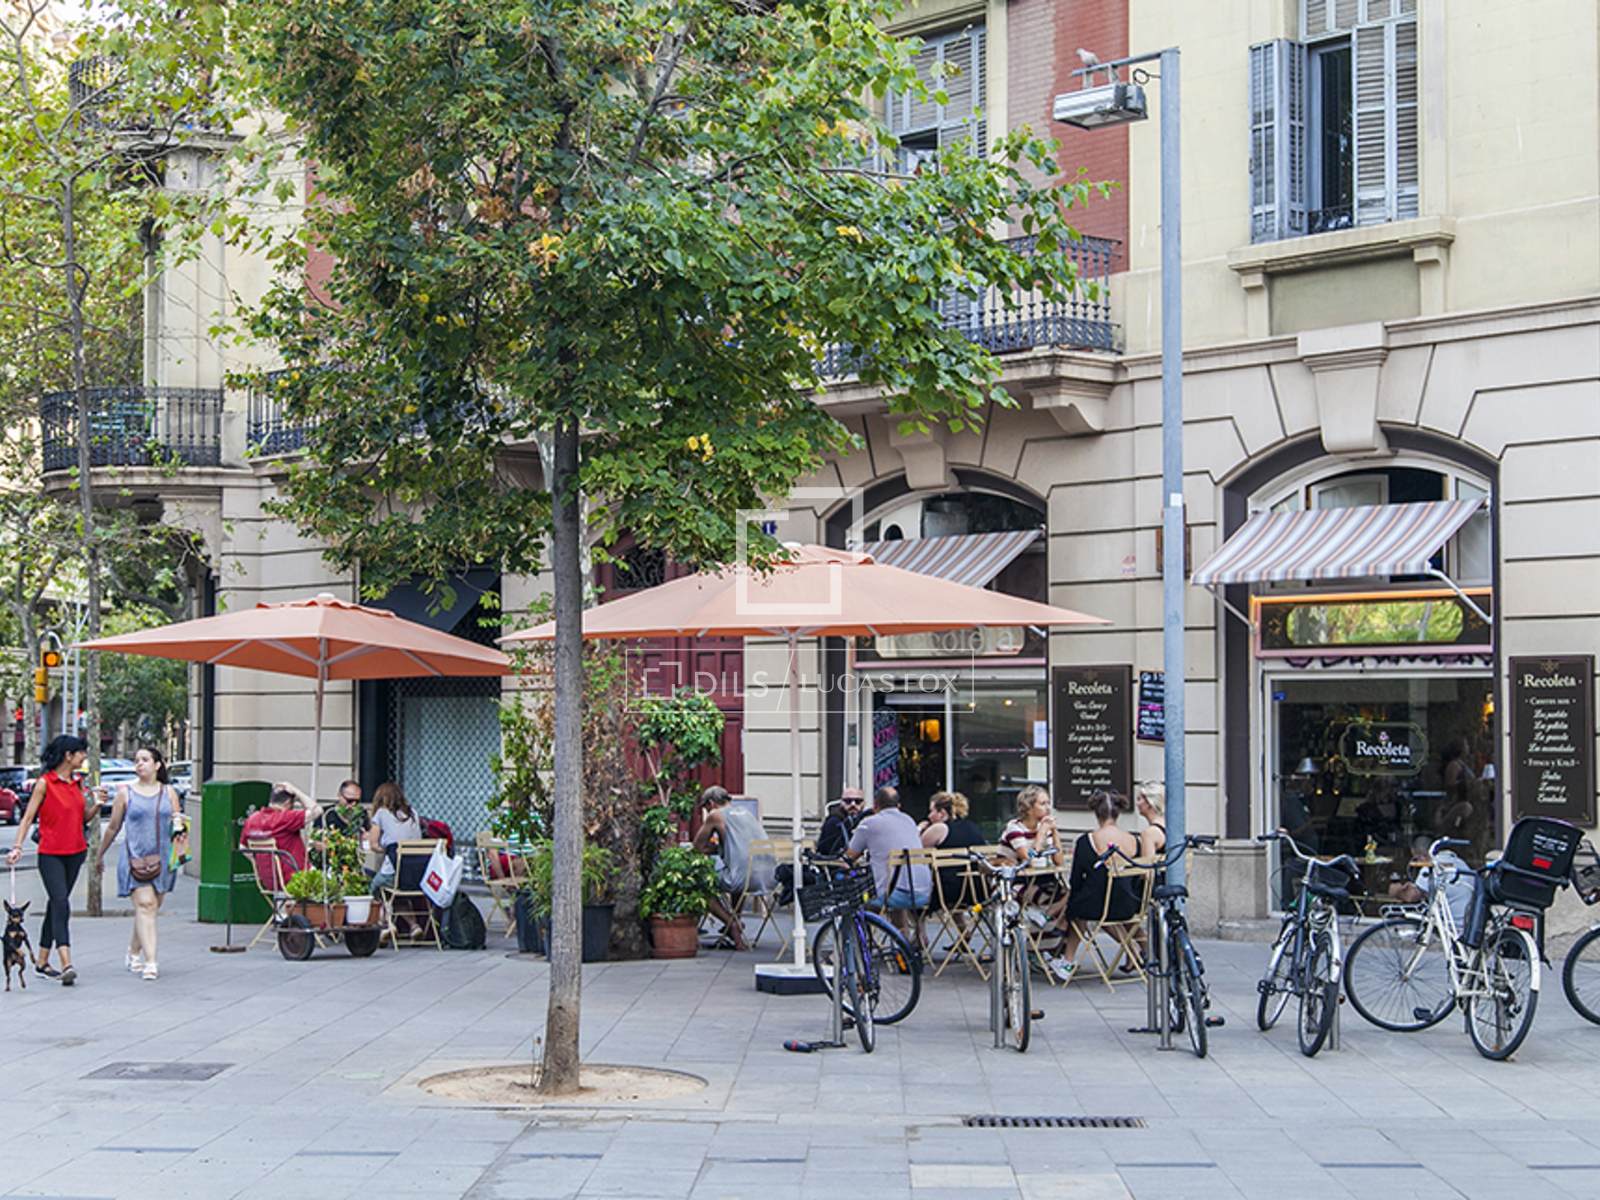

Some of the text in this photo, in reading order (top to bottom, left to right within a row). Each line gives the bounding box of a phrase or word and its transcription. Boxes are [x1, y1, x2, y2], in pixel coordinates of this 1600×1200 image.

[1068, 681, 1112, 695] Recoleta
[1524, 673, 1576, 688] Recoleta
[1356, 740, 1411, 756] Recoleta
